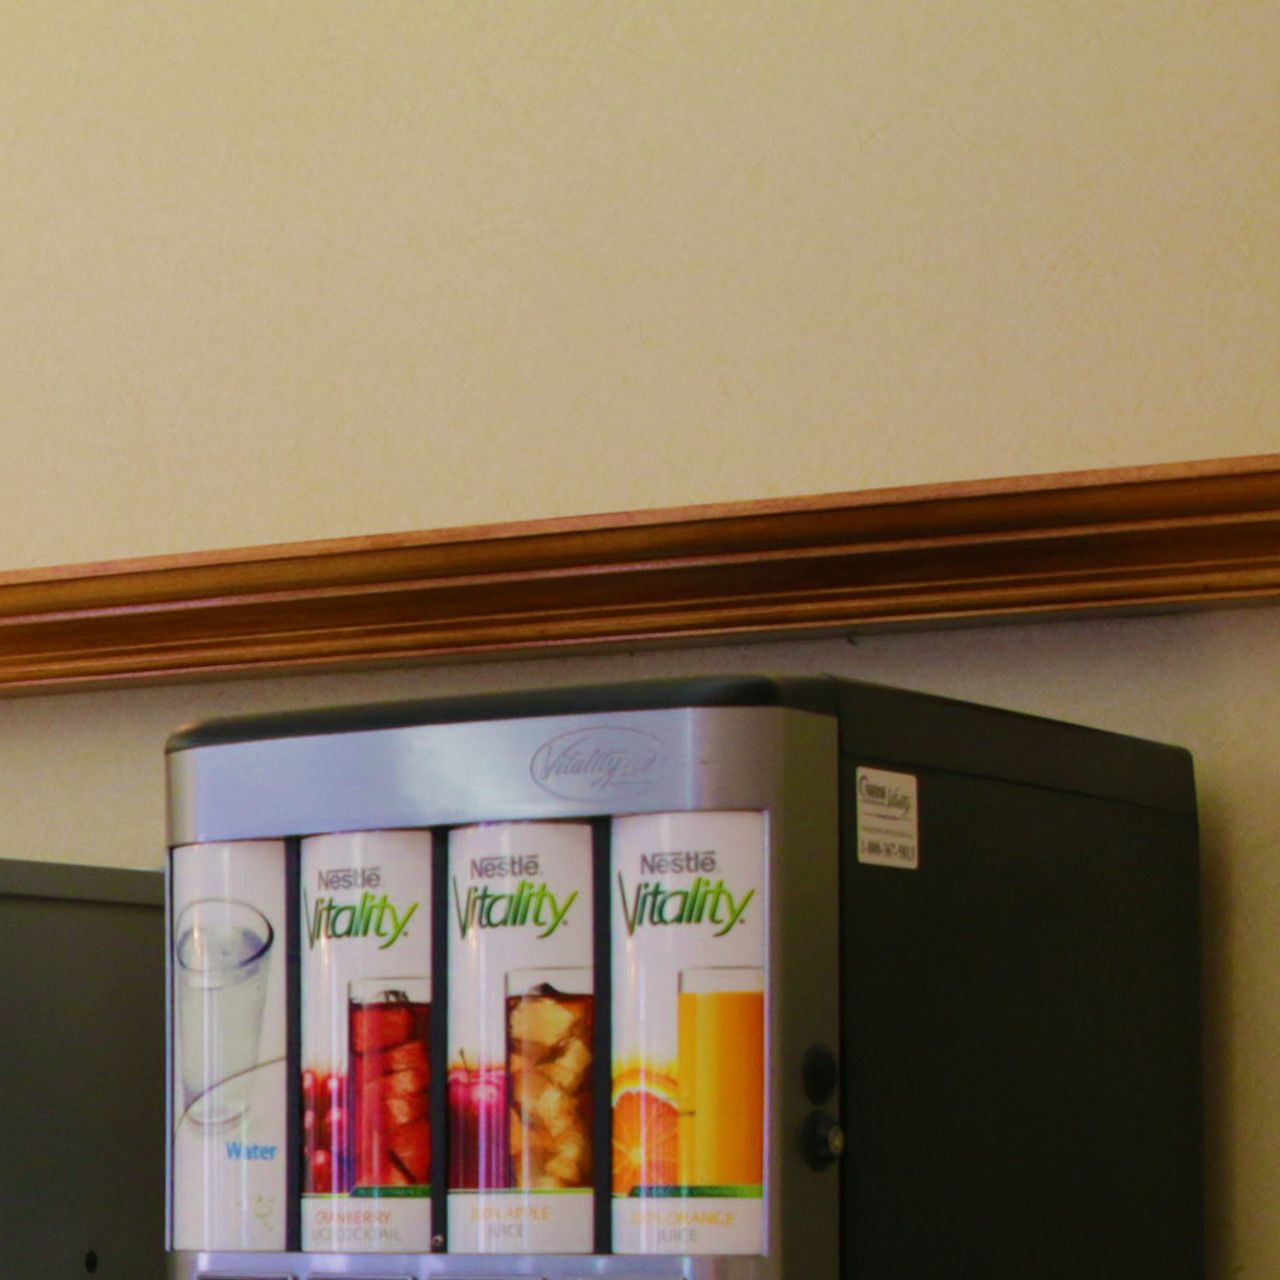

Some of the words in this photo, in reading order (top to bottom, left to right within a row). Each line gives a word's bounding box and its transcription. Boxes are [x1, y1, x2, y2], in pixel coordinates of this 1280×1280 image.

[303, 887, 420, 950] Vitality
[453, 873, 579, 940] Vitality
[618, 869, 756, 938] Vitality
[226, 1142, 276, 1161] Water
